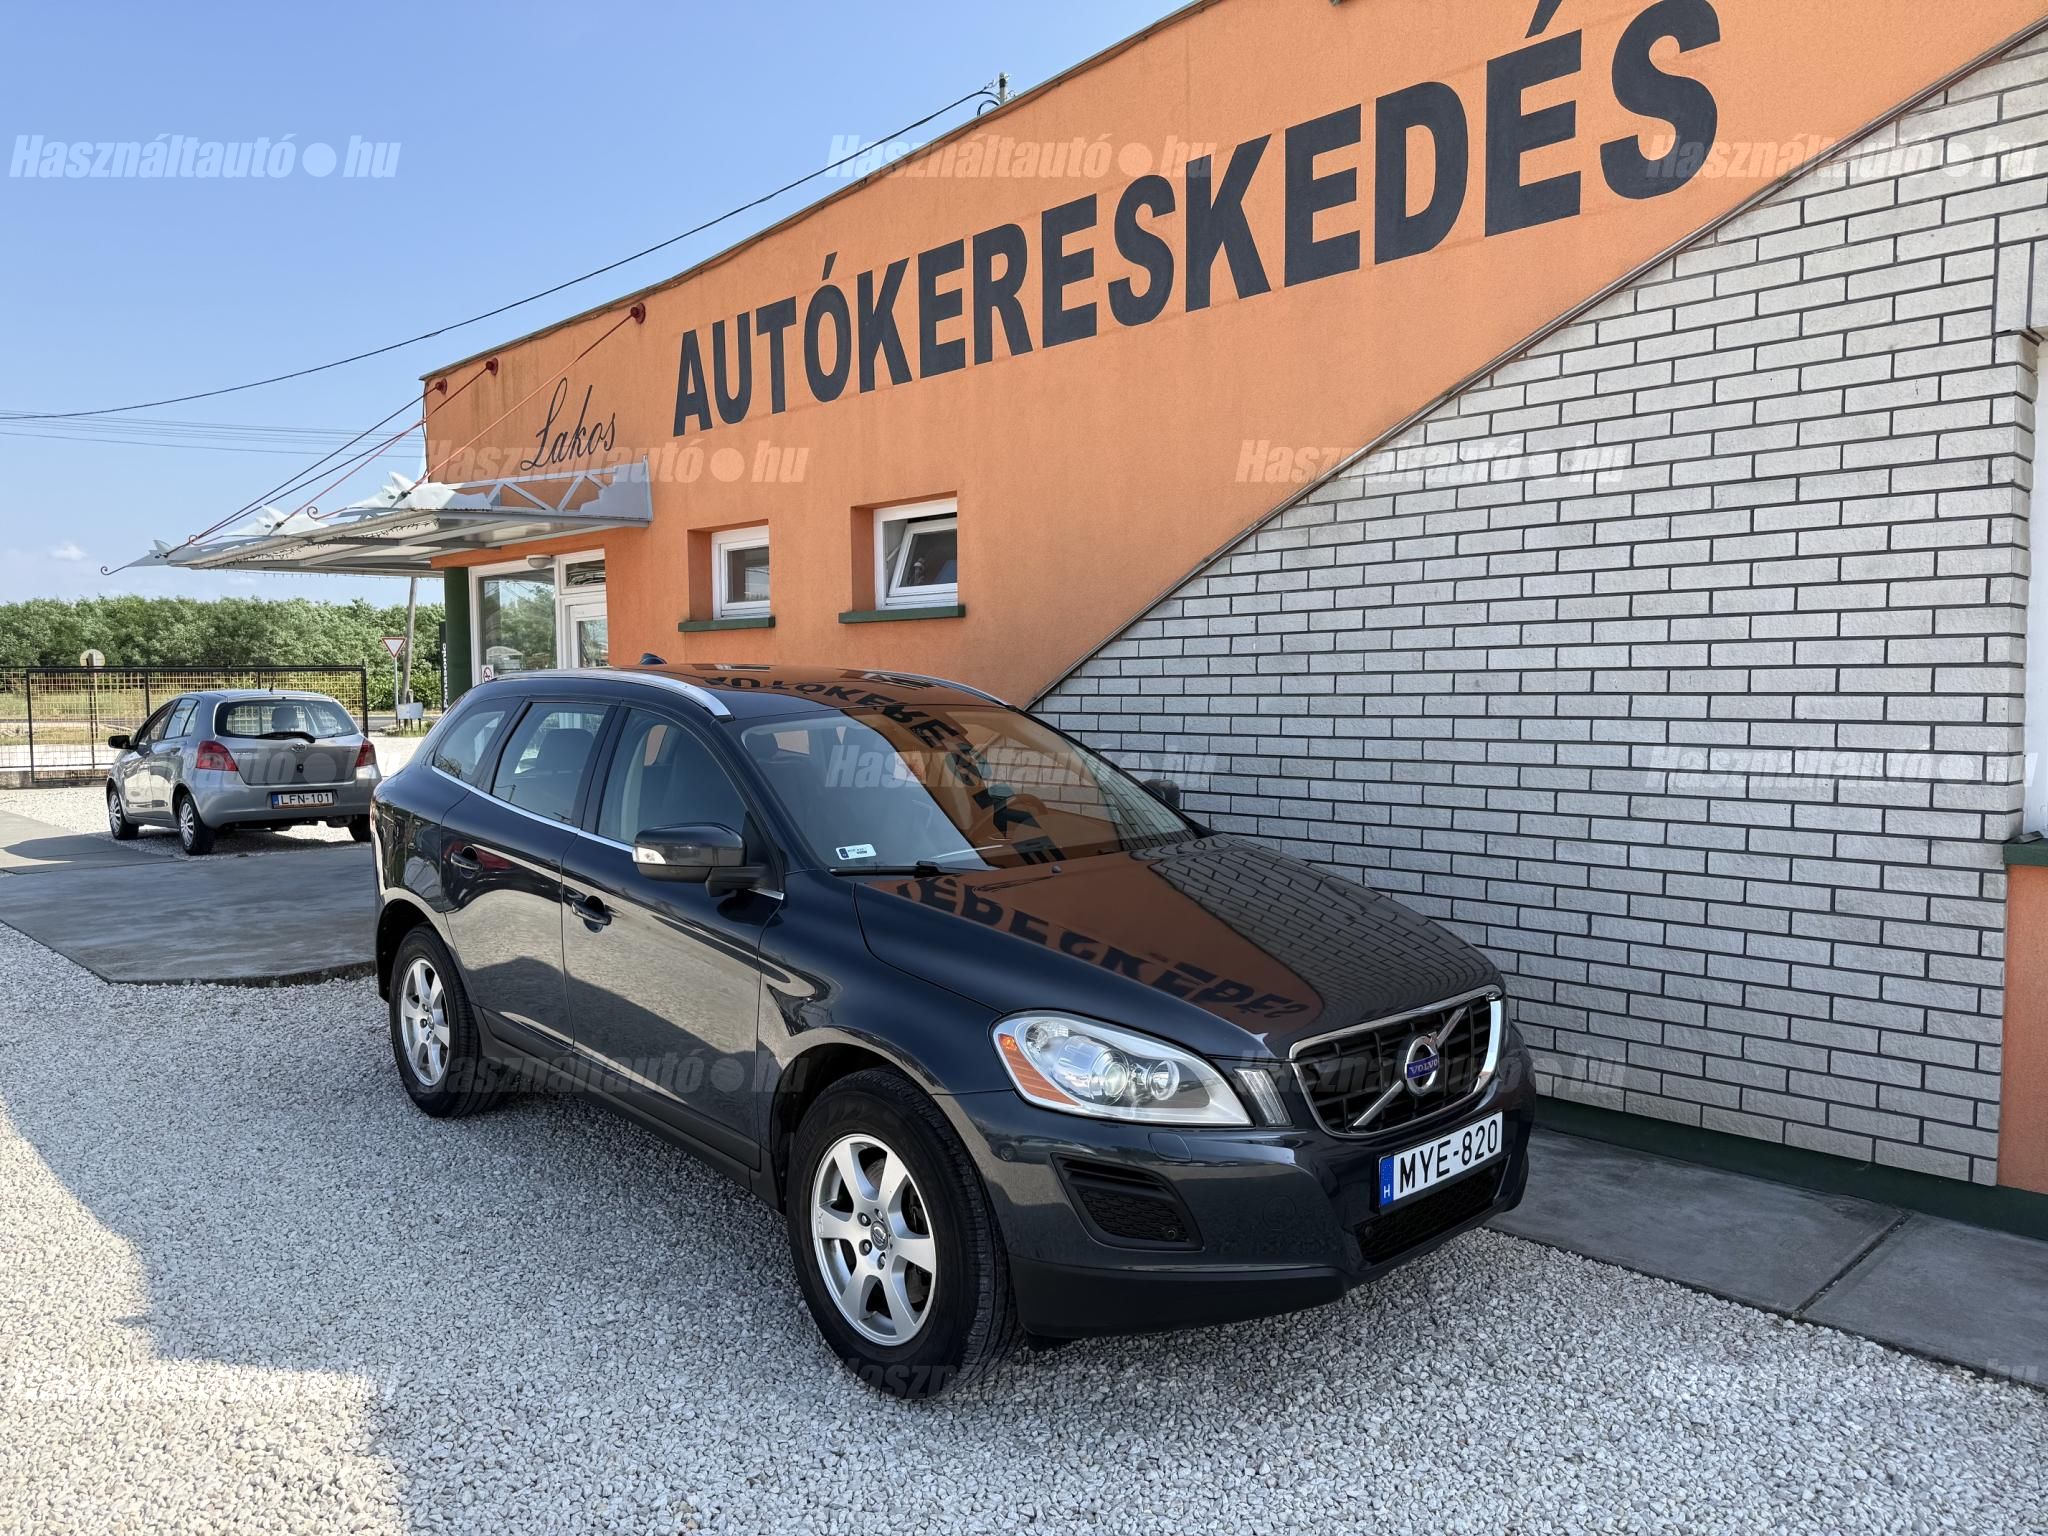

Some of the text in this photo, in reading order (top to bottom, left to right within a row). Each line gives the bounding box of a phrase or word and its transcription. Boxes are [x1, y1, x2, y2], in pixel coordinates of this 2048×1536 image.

[673, 0, 1720, 437] AUTÓKERESKEDÉS
[520, 377, 615, 471] Lakos
[281, 793, 330, 805] LFN-101
[1409, 1058, 1439, 1074] VOLVO
[1383, 1119, 1498, 1199] H MYE-820
